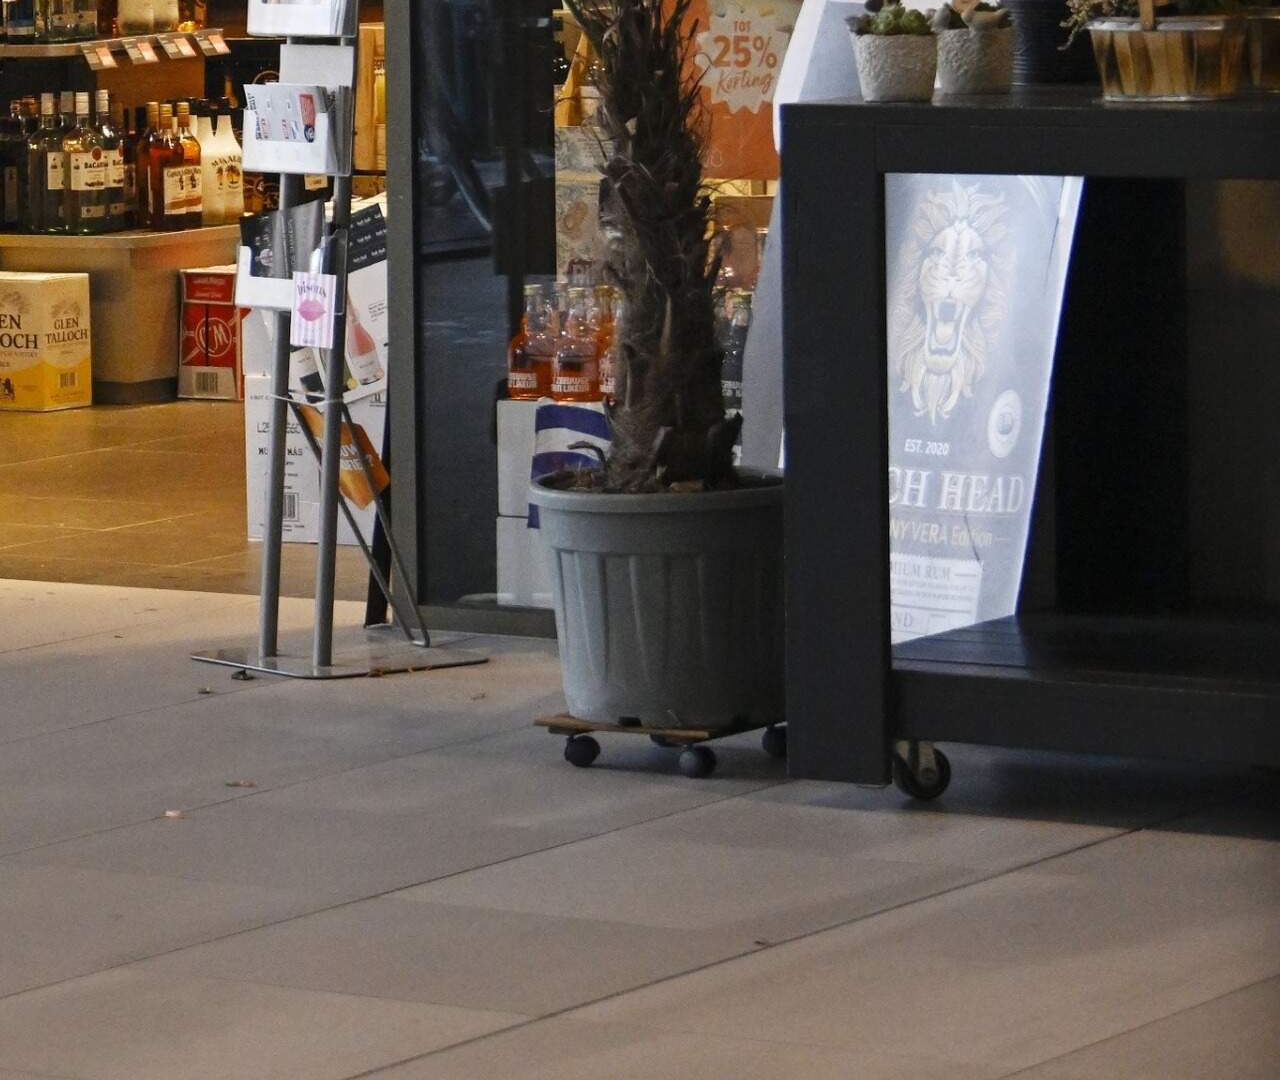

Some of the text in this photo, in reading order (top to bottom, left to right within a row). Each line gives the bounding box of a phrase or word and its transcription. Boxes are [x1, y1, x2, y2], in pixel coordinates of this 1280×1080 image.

[712, 35, 778, 70] 25%
[715, 69, 774, 94] Korting
[54, 317, 79, 330] GLEN
[45, 328, 89, 345] TALLOCH
[903, 438, 951, 457] EST. 2020
[937, 472, 1024, 513] HEAD
[911, 521, 948, 545] VERA
